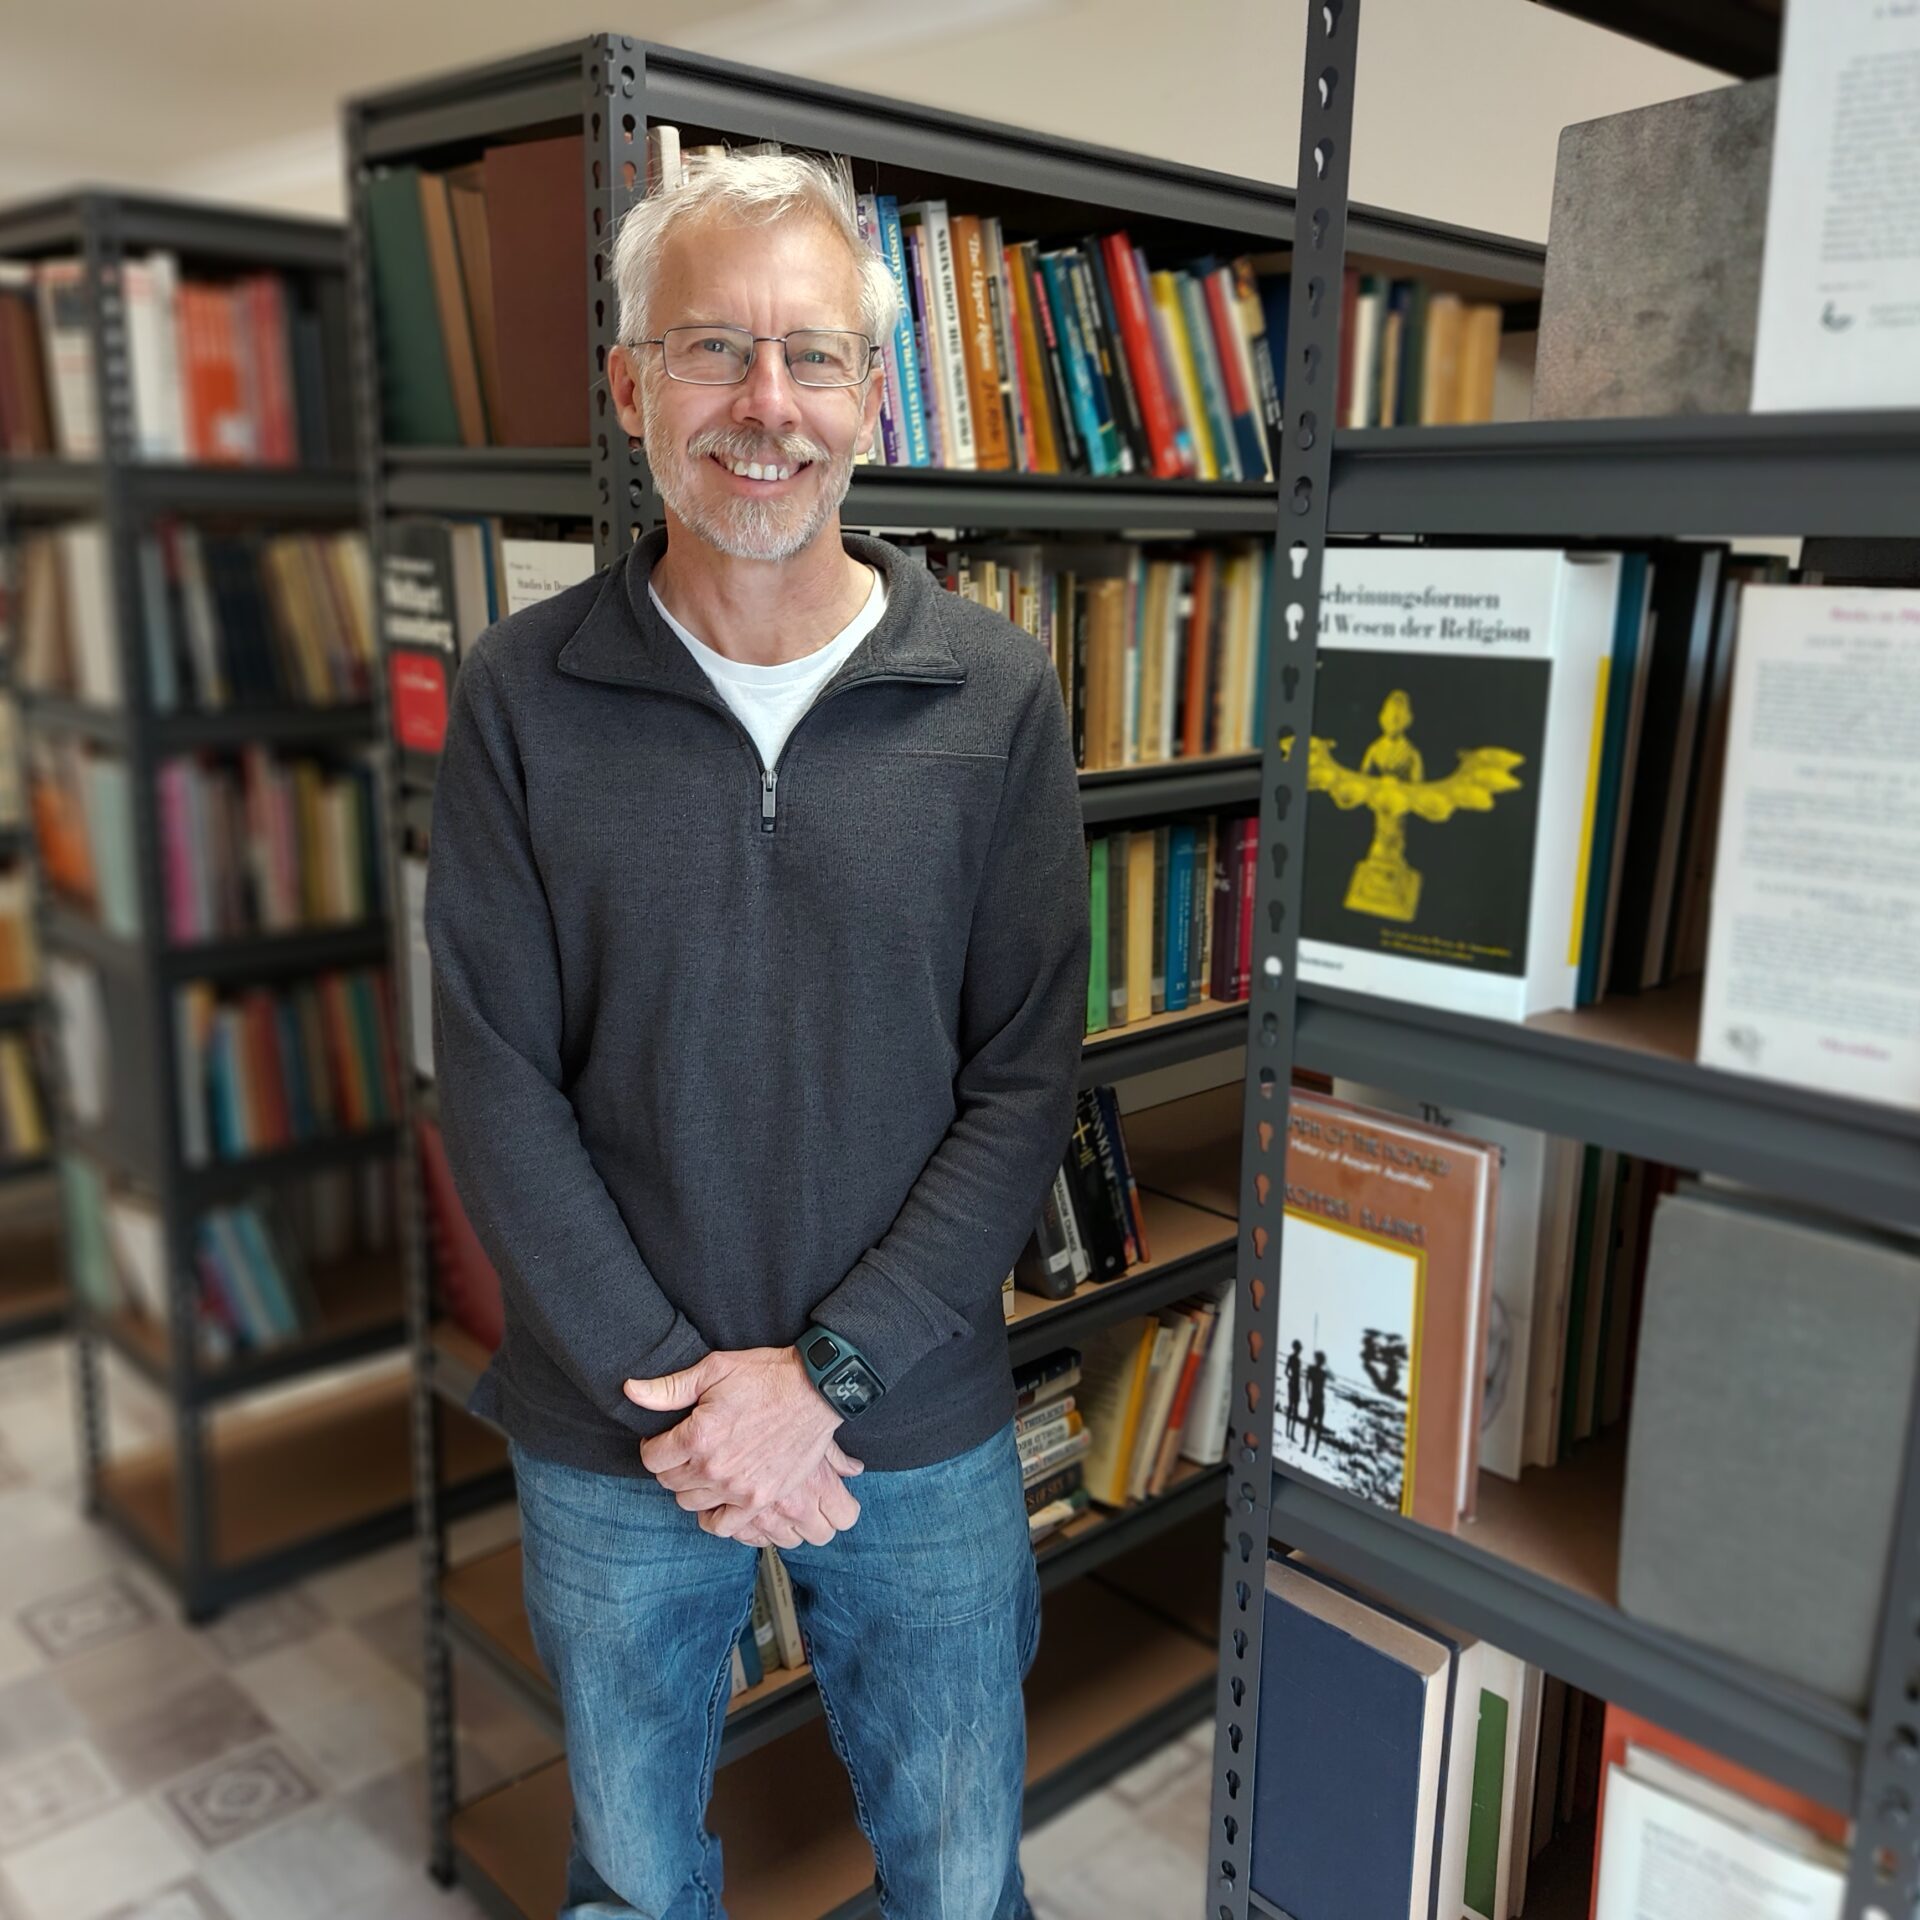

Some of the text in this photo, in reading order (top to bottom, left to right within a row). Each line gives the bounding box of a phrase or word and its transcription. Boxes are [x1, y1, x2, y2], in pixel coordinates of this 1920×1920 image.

[938, 229, 951, 272] NEWS
[943, 274, 957, 321] GOOD
[971, 270, 987, 322] Upper
[900, 328, 926, 462] TEACH US TO PRAY
[1334, 613, 1396, 638] Wesen
[1399, 616, 1435, 639] der
[1440, 616, 1531, 645] Religion
[836, 1376, 860, 1401] 55
